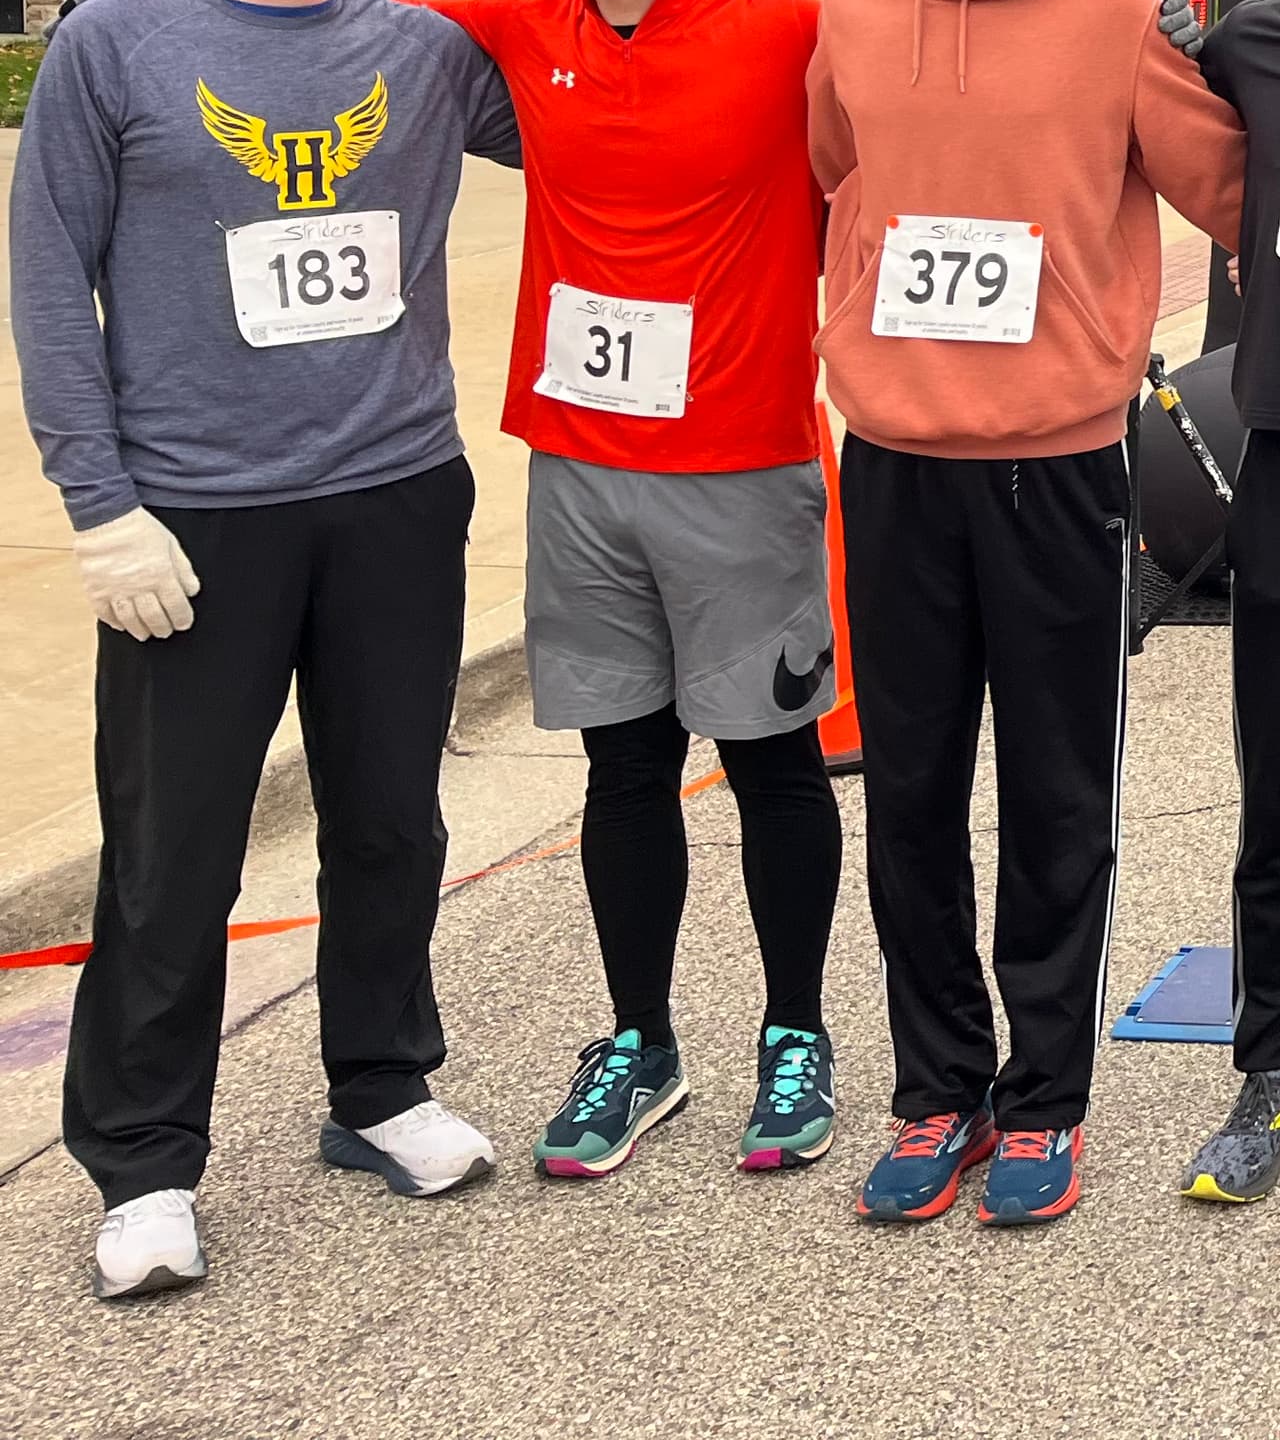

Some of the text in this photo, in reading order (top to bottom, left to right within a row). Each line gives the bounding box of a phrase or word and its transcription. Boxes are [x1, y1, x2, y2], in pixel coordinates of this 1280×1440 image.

[278, 134, 331, 206] H
[272, 218, 365, 243] Striders
[914, 223, 1007, 243] Striders
[267, 245, 371, 309] 183
[904, 249, 1009, 308] 379
[576, 300, 656, 323] Striders
[583, 325, 633, 382] 31
